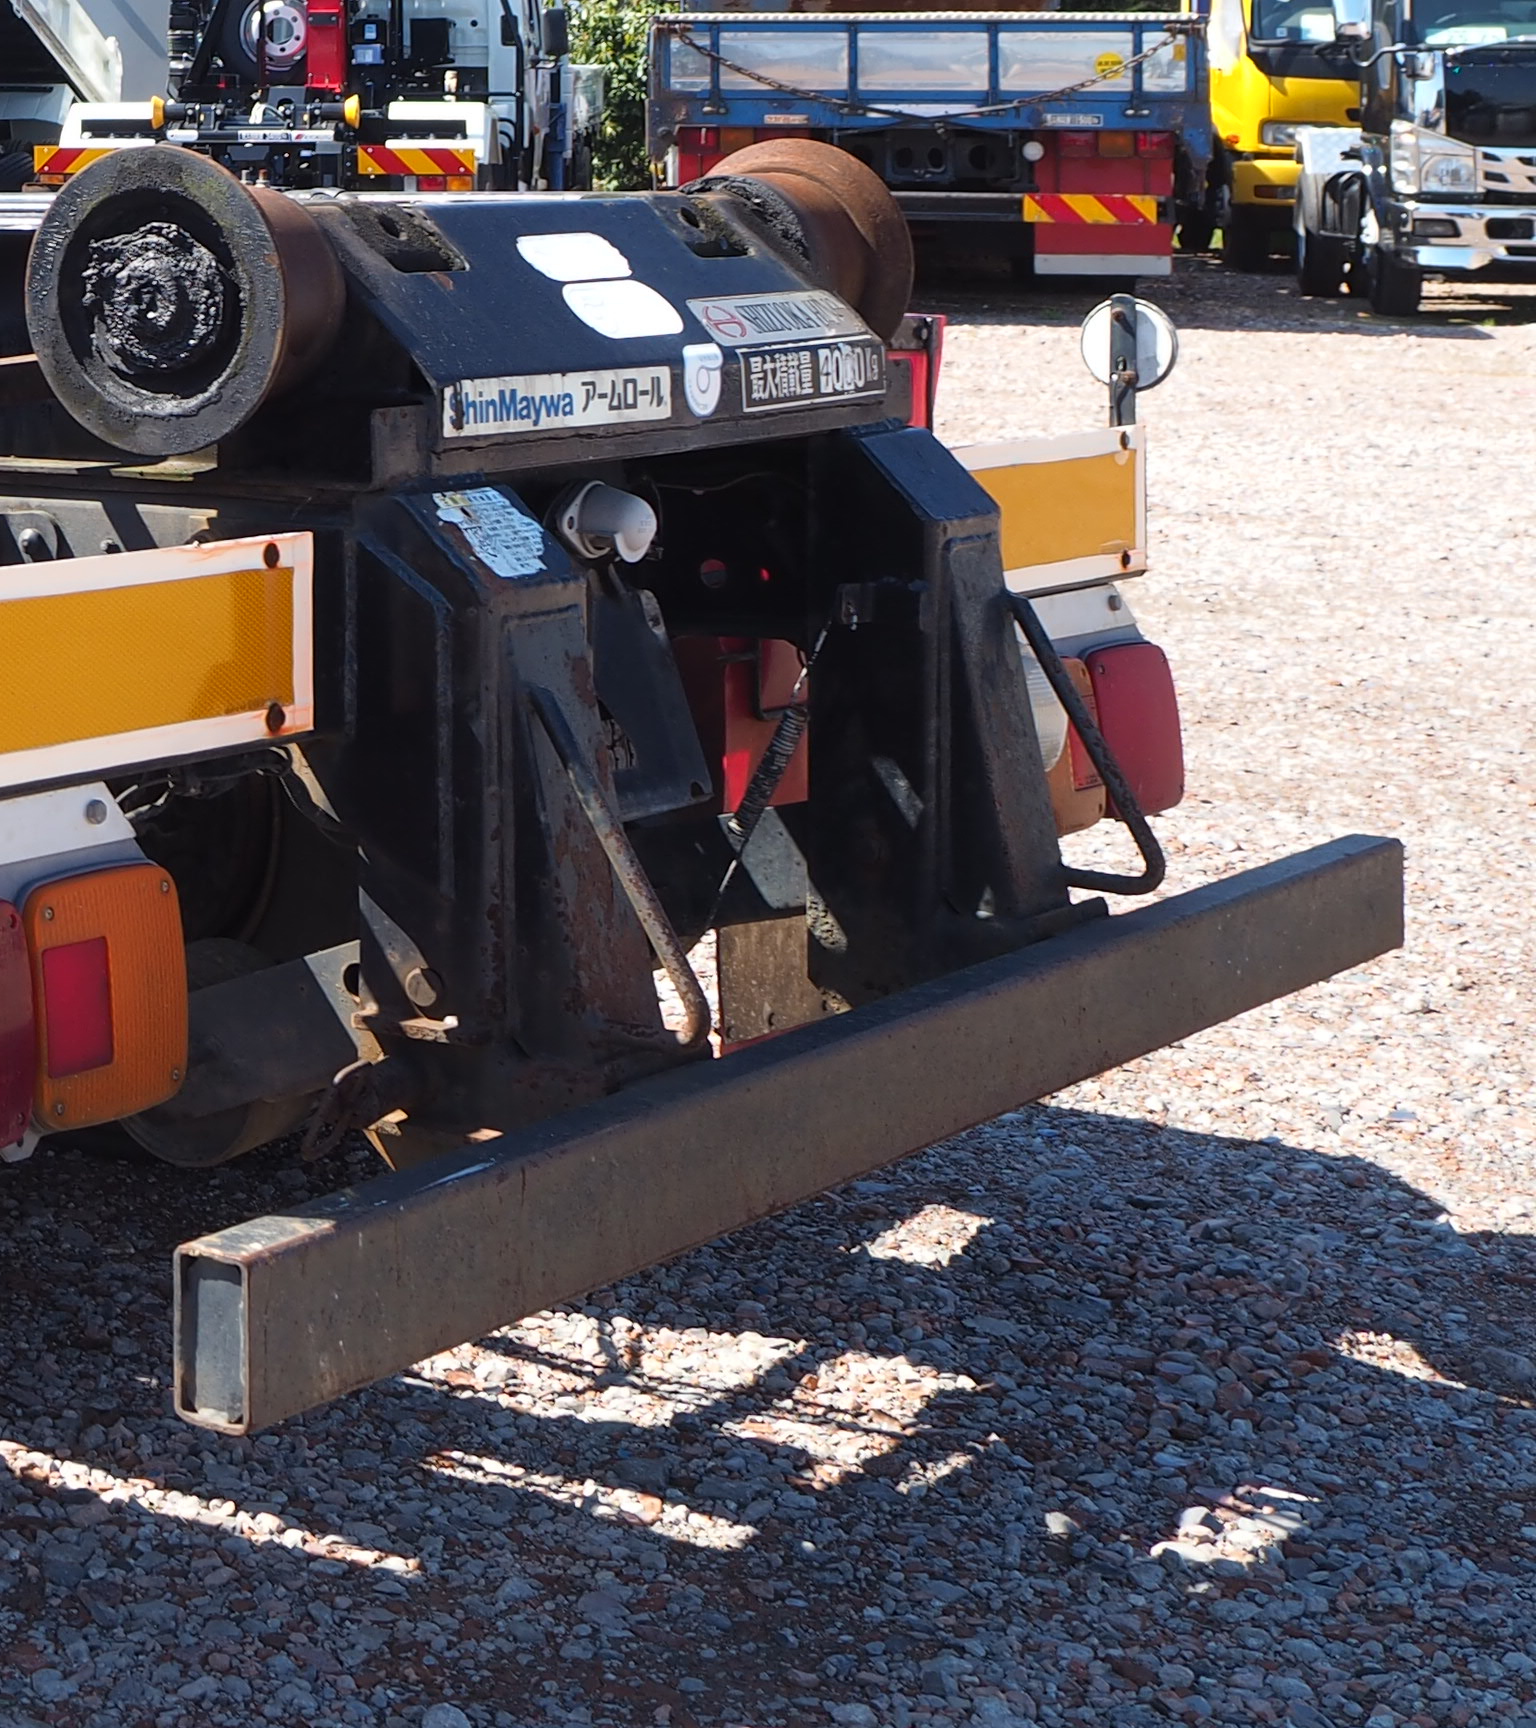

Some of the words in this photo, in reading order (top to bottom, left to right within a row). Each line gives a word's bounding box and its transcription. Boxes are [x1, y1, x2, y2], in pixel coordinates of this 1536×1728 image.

[449, 387, 574, 427] ShinMaywa
[581, 375, 665, 414] アームロール
[749, 351, 814, 401] 最大積載量
